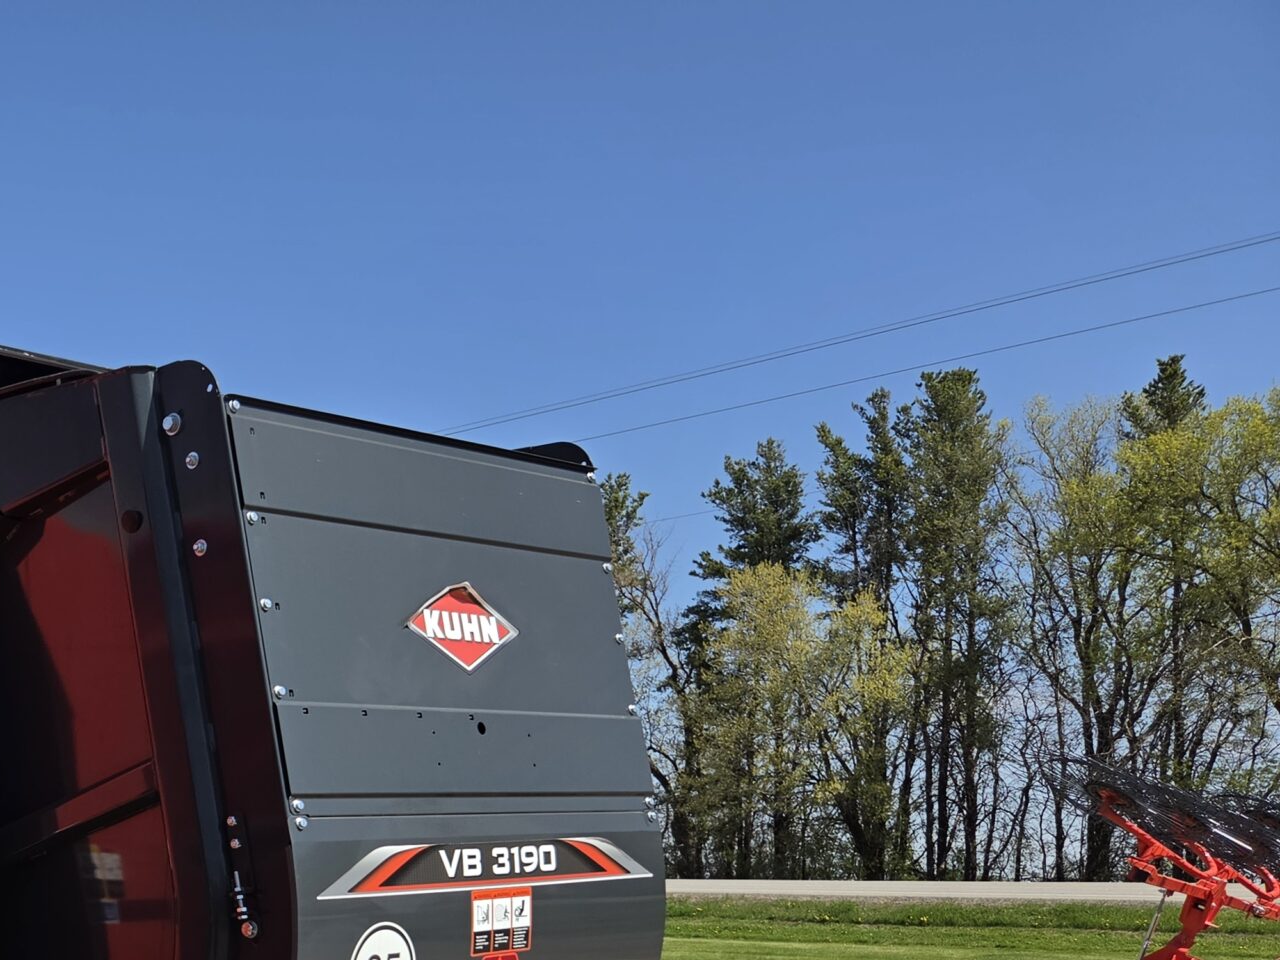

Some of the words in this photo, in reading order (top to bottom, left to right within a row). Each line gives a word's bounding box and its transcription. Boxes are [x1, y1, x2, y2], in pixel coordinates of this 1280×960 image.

[423, 609, 500, 644] KUHN
[438, 848, 482, 878] VB
[491, 844, 557, 875] 3190
